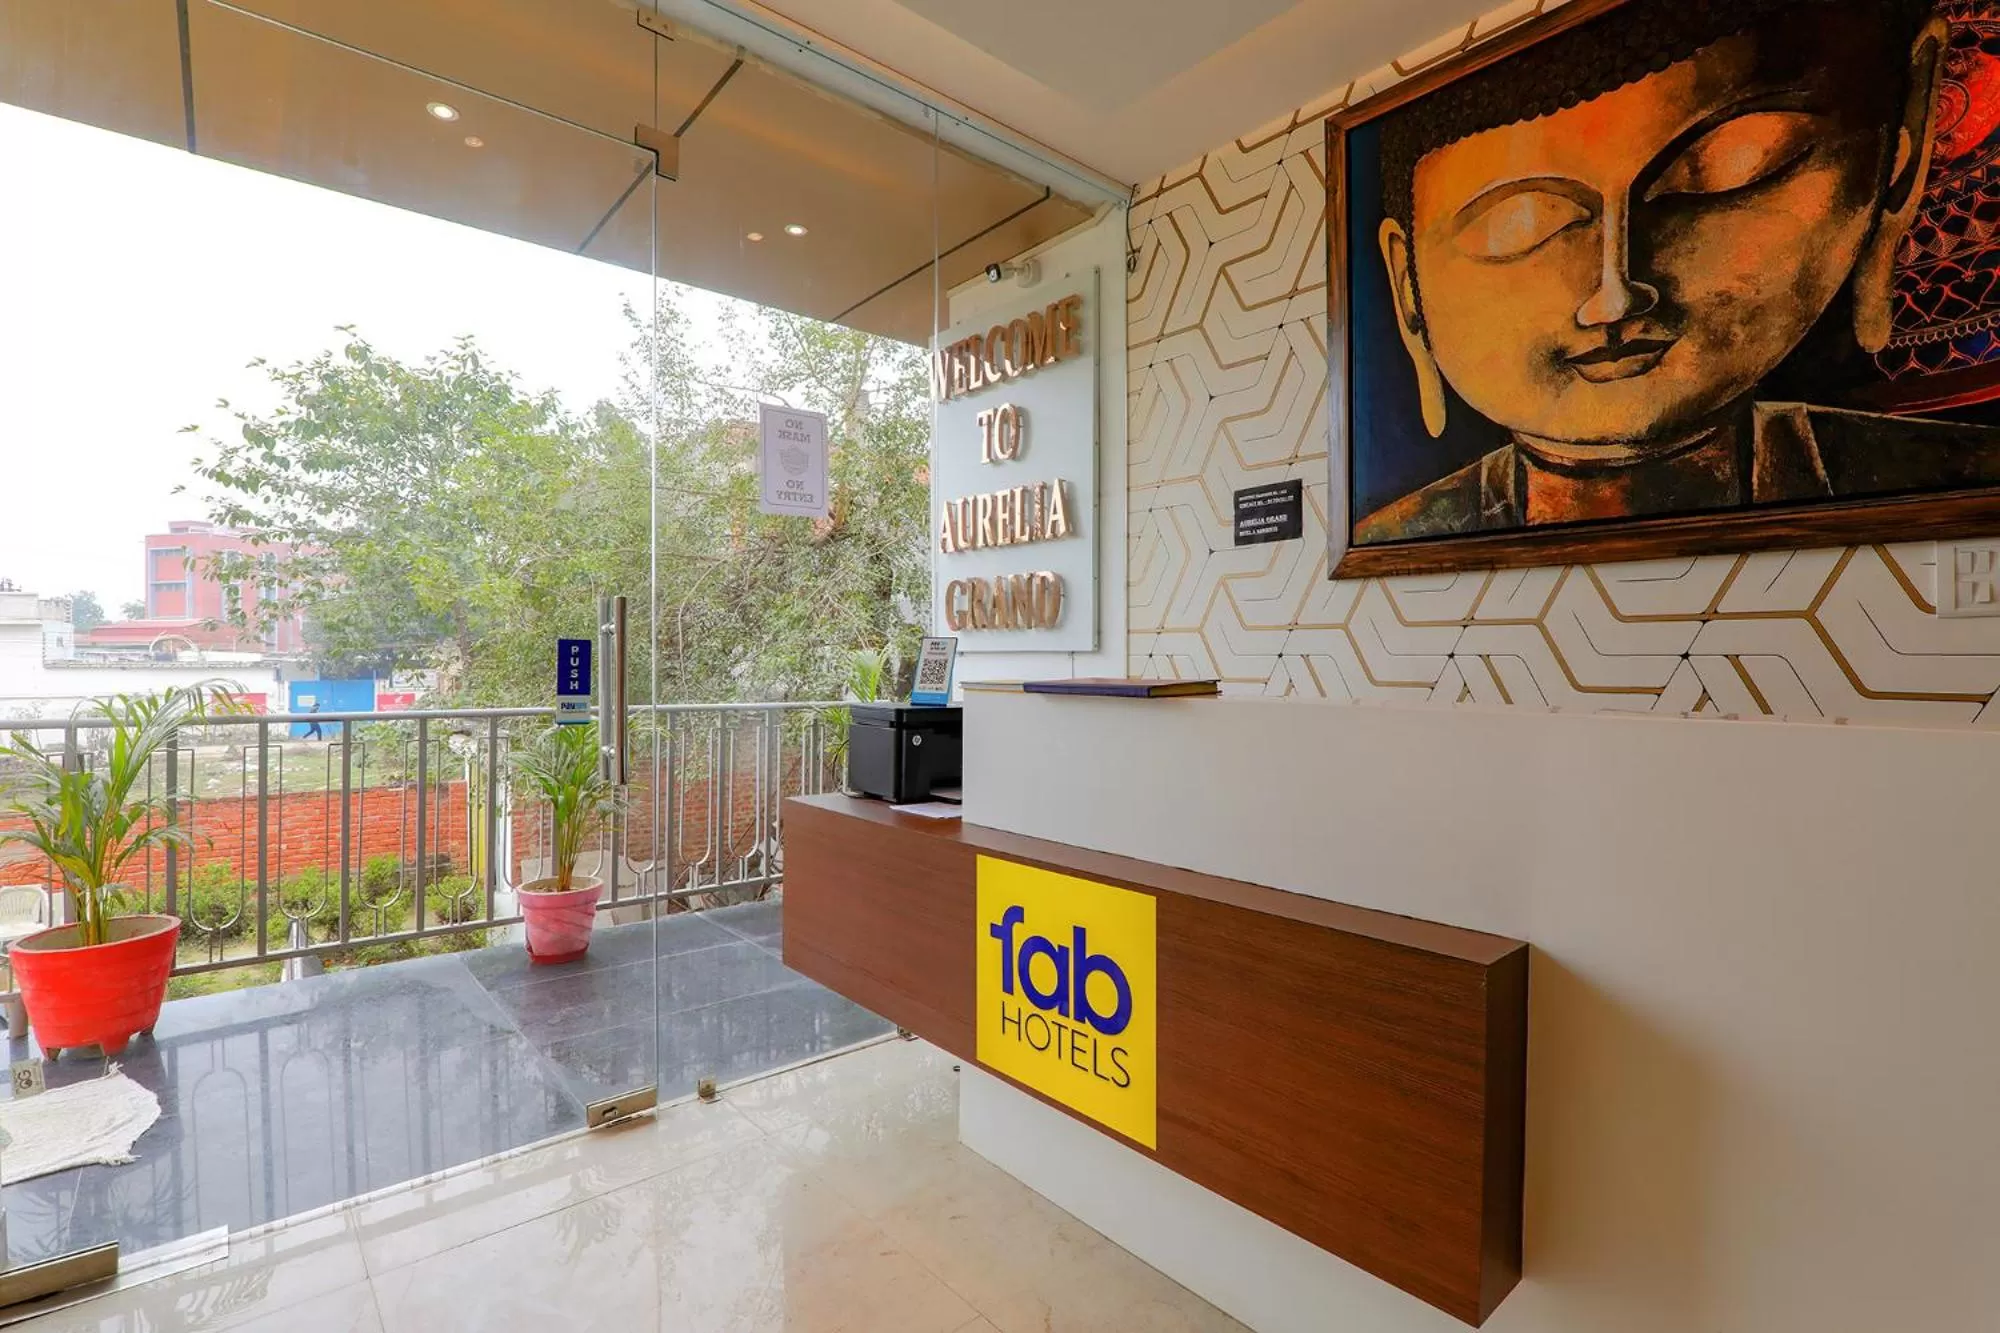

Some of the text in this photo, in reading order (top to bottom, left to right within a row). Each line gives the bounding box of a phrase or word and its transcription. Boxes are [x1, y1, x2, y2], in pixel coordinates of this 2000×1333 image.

[928, 294, 1083, 402] WELCOME
[977, 402, 1023, 464] TO
[939, 478, 1074, 554] AURELIA
[945, 571, 1065, 631] GRAND
[569, 645, 580, 690] PUSH
[990, 905, 1133, 1036] fab
[1002, 1001, 1131, 1089] HOTELS
